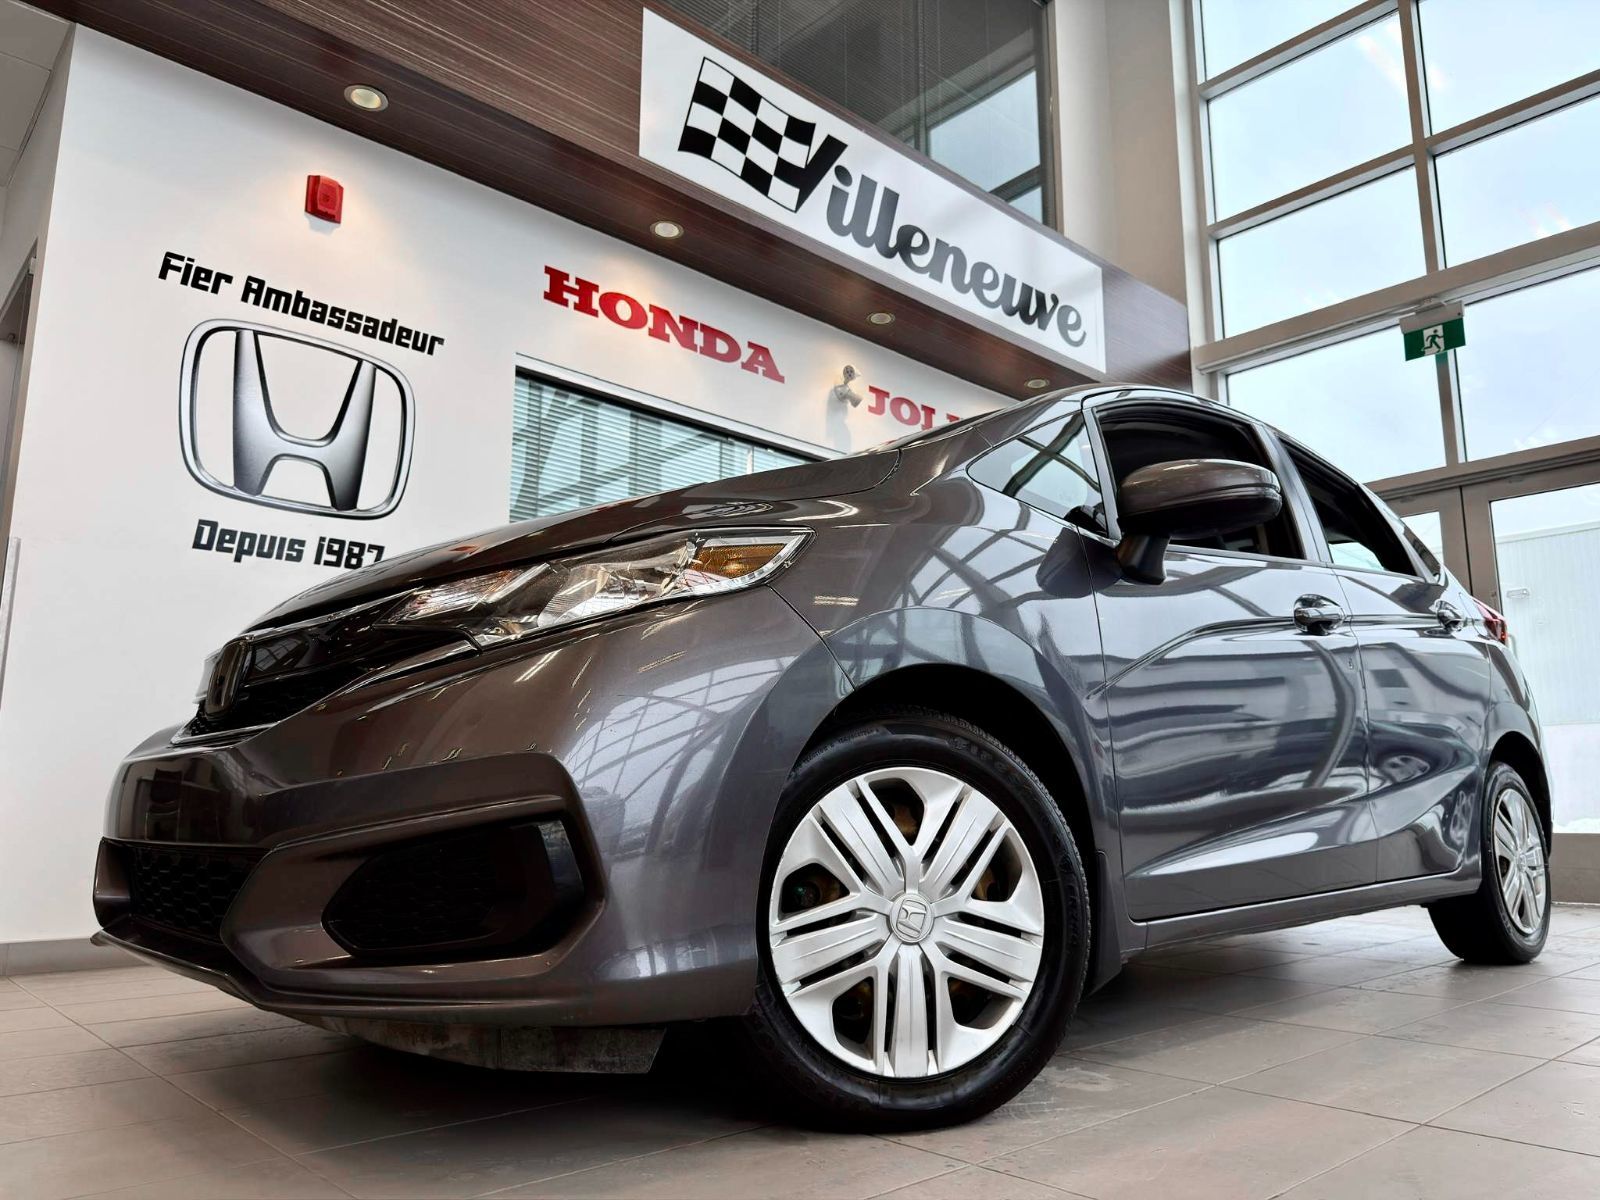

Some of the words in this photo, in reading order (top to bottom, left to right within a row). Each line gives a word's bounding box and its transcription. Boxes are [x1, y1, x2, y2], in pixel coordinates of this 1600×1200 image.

[770, 118, 1087, 347] Villeneuve
[158, 251, 234, 294] Fier
[240, 275, 445, 355] Ambassadeur
[543, 265, 785, 384] HONDA
[192, 519, 306, 563] Depuis
